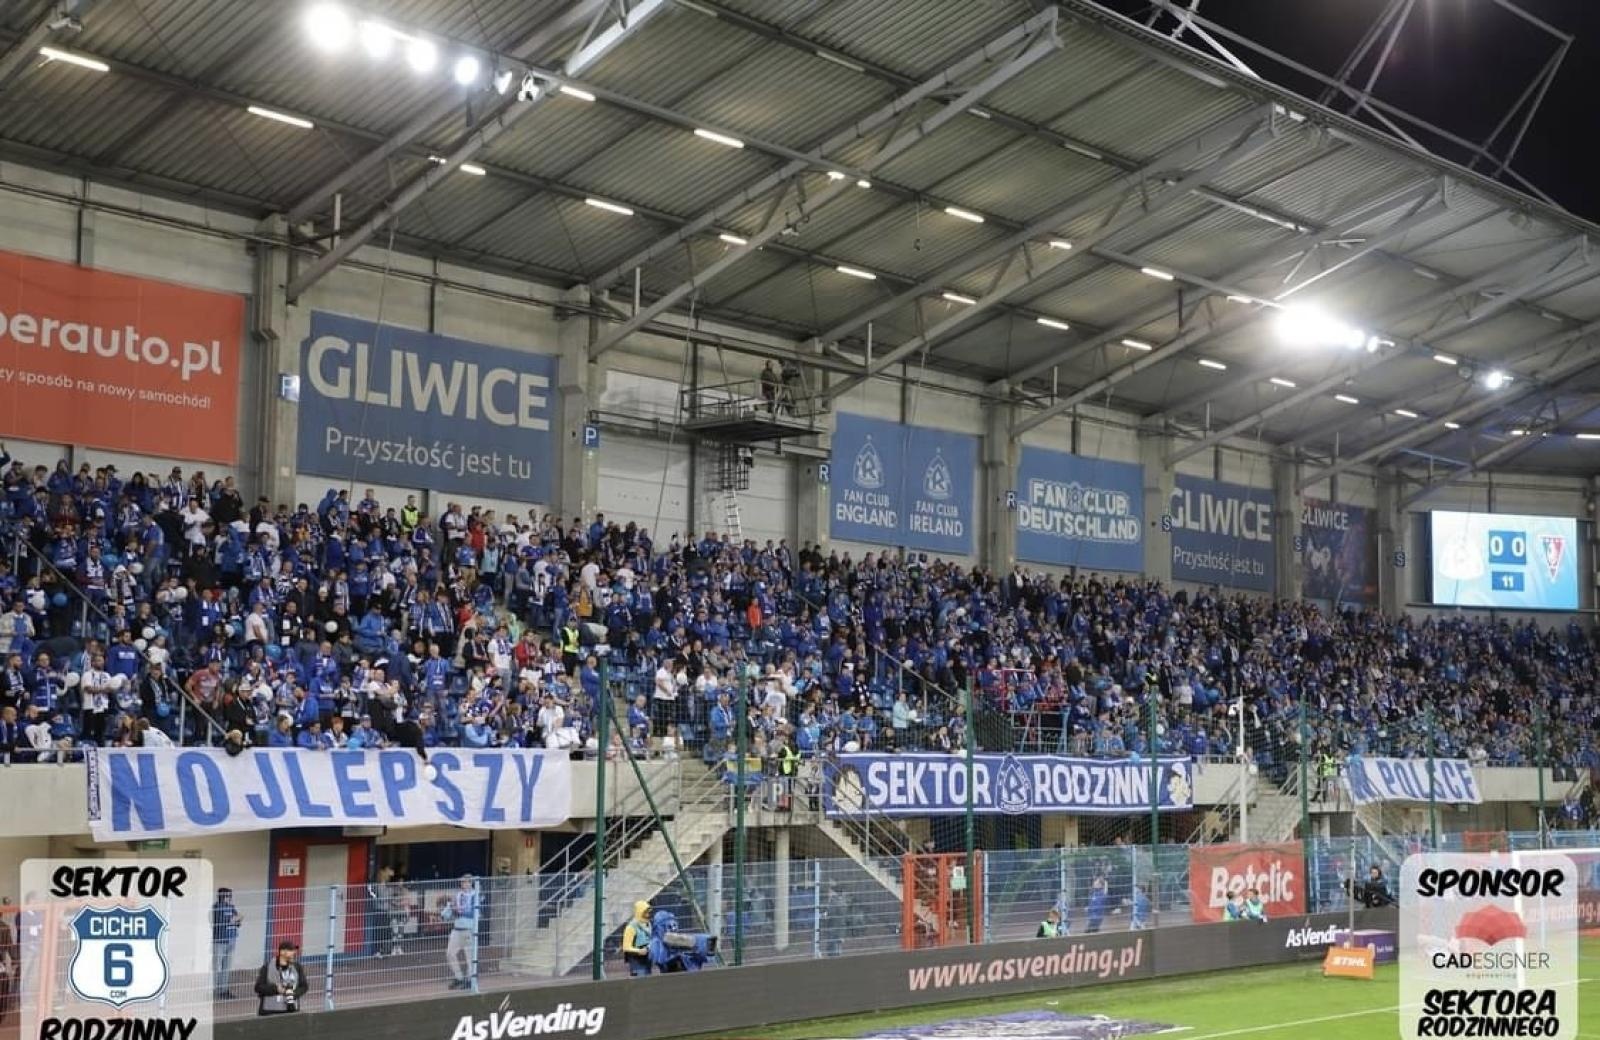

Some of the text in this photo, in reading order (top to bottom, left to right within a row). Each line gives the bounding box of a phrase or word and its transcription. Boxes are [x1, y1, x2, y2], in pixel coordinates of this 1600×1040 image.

[19, 369, 74, 388] sposób
[77, 379, 95, 392] na
[98, 382, 136, 400] nowy
[307, 335, 550, 431] GLIWICE
[585, 427, 596, 445] P
[325, 426, 531, 479] Przyszłość jest tu
[819, 465, 829, 480] R
[844, 488, 890, 508] FAN CLUB
[915, 500, 959, 517] FAN CLUB
[1006, 492, 1015, 505] R
[1031, 481, 1130, 516] FAN CLUB
[835, 503, 899, 529] ENGLAND
[909, 513, 964, 537] IRELAND
[1018, 506, 1140, 540] DEUTSCHLAND
[1163, 516, 1171, 531] S
[1169, 487, 1272, 542] GLIWICE
[1490, 535, 1525, 557] 0 0
[1502, 575, 1515, 588] 11
[109, 750, 545, 832] NOJLEPSZY
[868, 761, 992, 806] SEKTOR
[1033, 763, 1164, 805] RODZINNY
[1209, 859, 1294, 909] Betclic
[908, 938, 1143, 991] www.asvending.pl
[450, 1003, 606, 1040] AsVending
